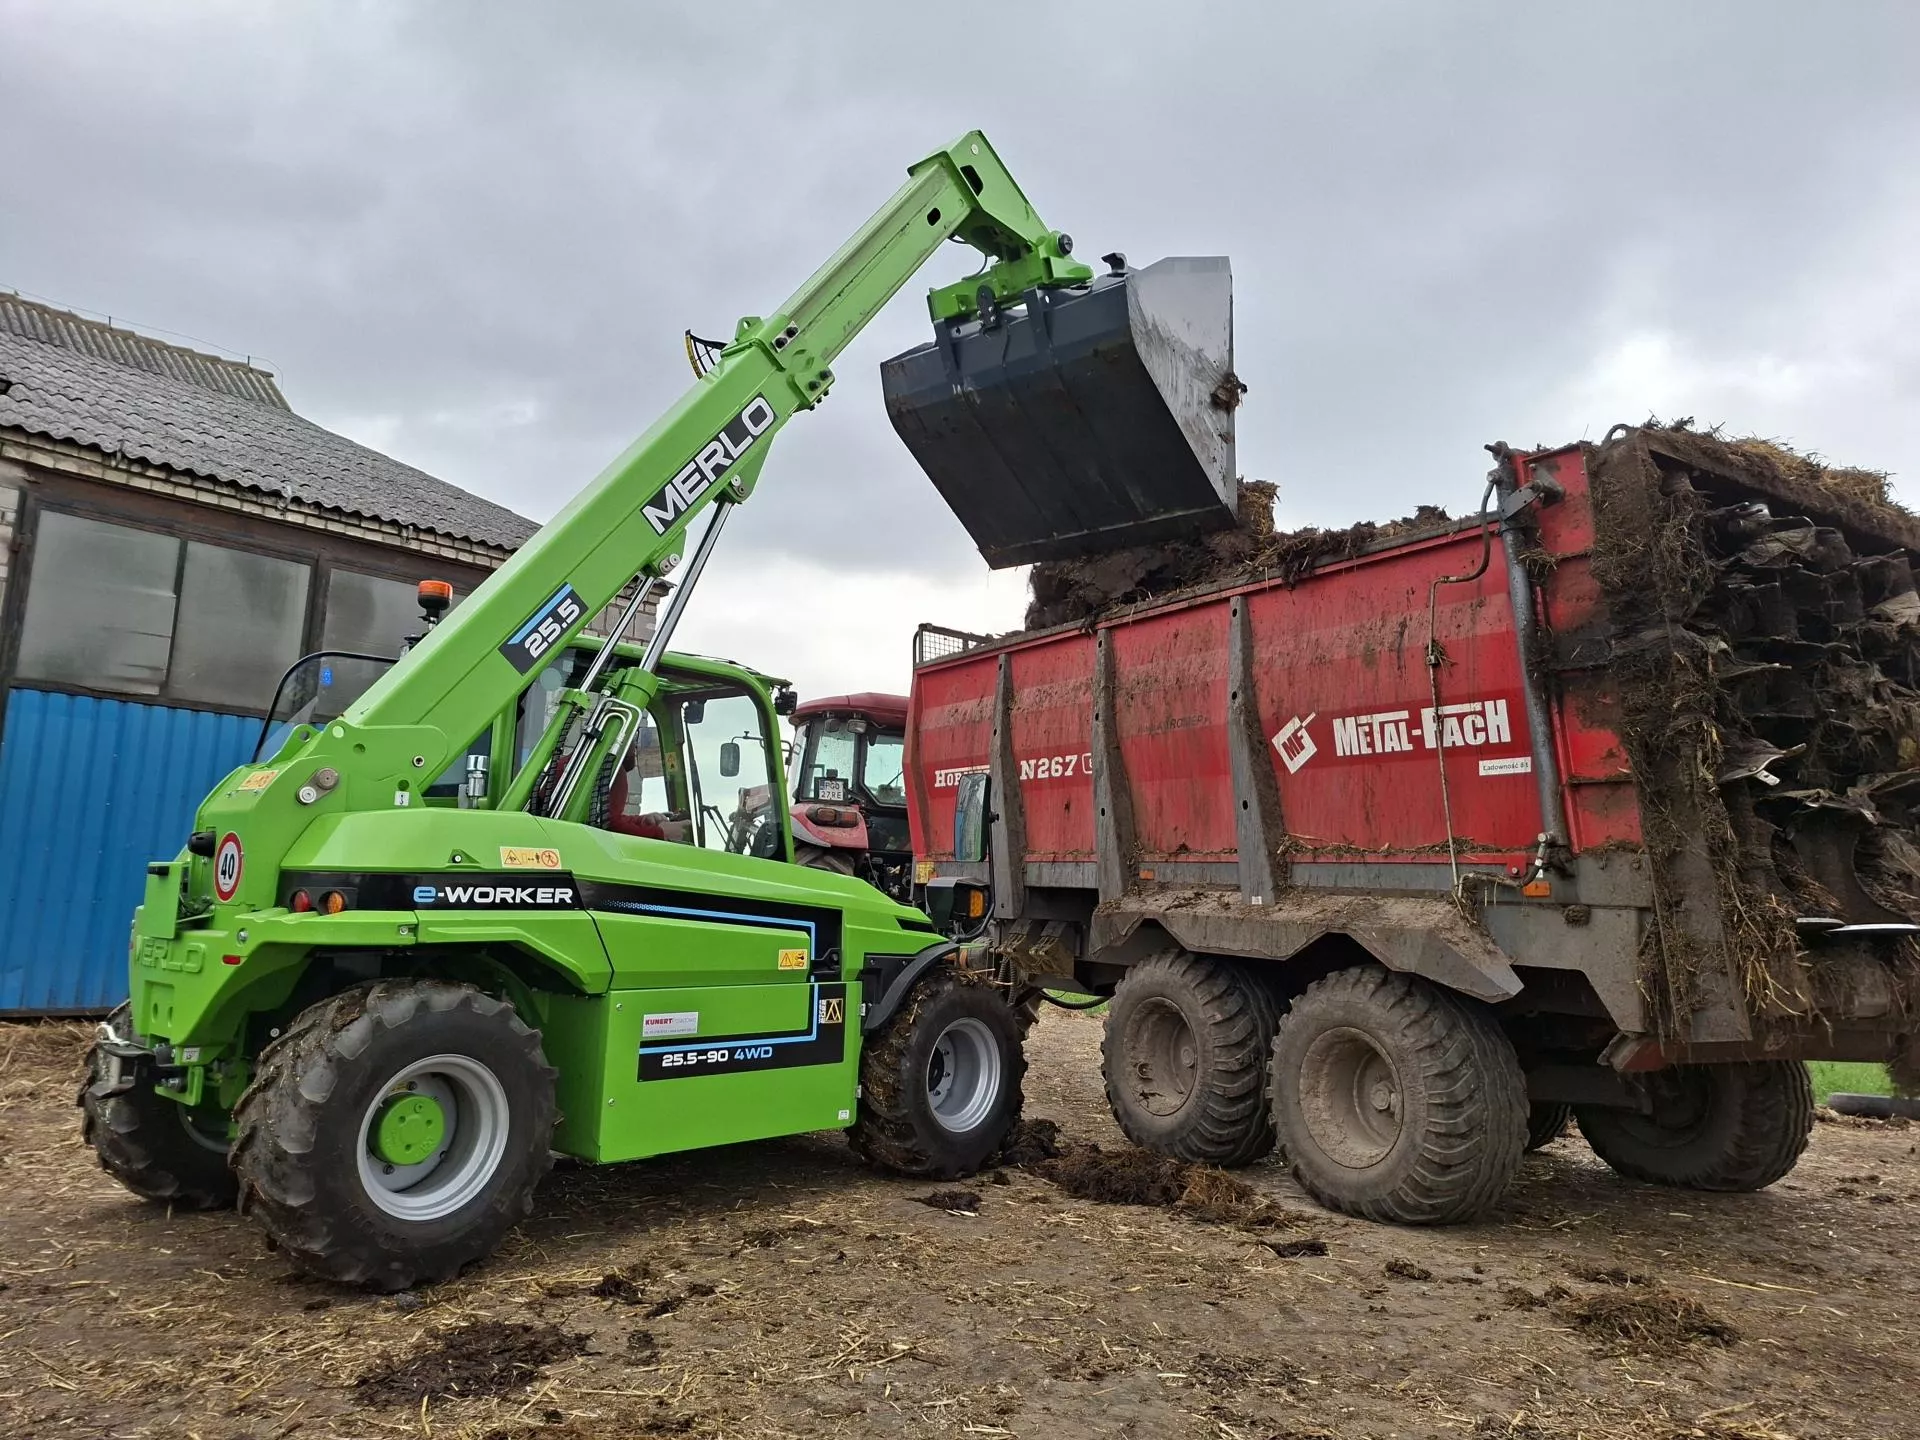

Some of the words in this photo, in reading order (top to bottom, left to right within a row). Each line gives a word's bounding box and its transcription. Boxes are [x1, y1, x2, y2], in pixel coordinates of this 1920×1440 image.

[641, 397, 775, 535] MERLO
[525, 598, 580, 658] 25.5
[1019, 755, 1078, 780] N267
[821, 790, 842, 799] 27RE
[221, 853, 235, 880] 40
[413, 886, 573, 904] e-WORKER
[662, 1050, 728, 1067] 25.5-90
[734, 1047, 773, 1060] 4WD
